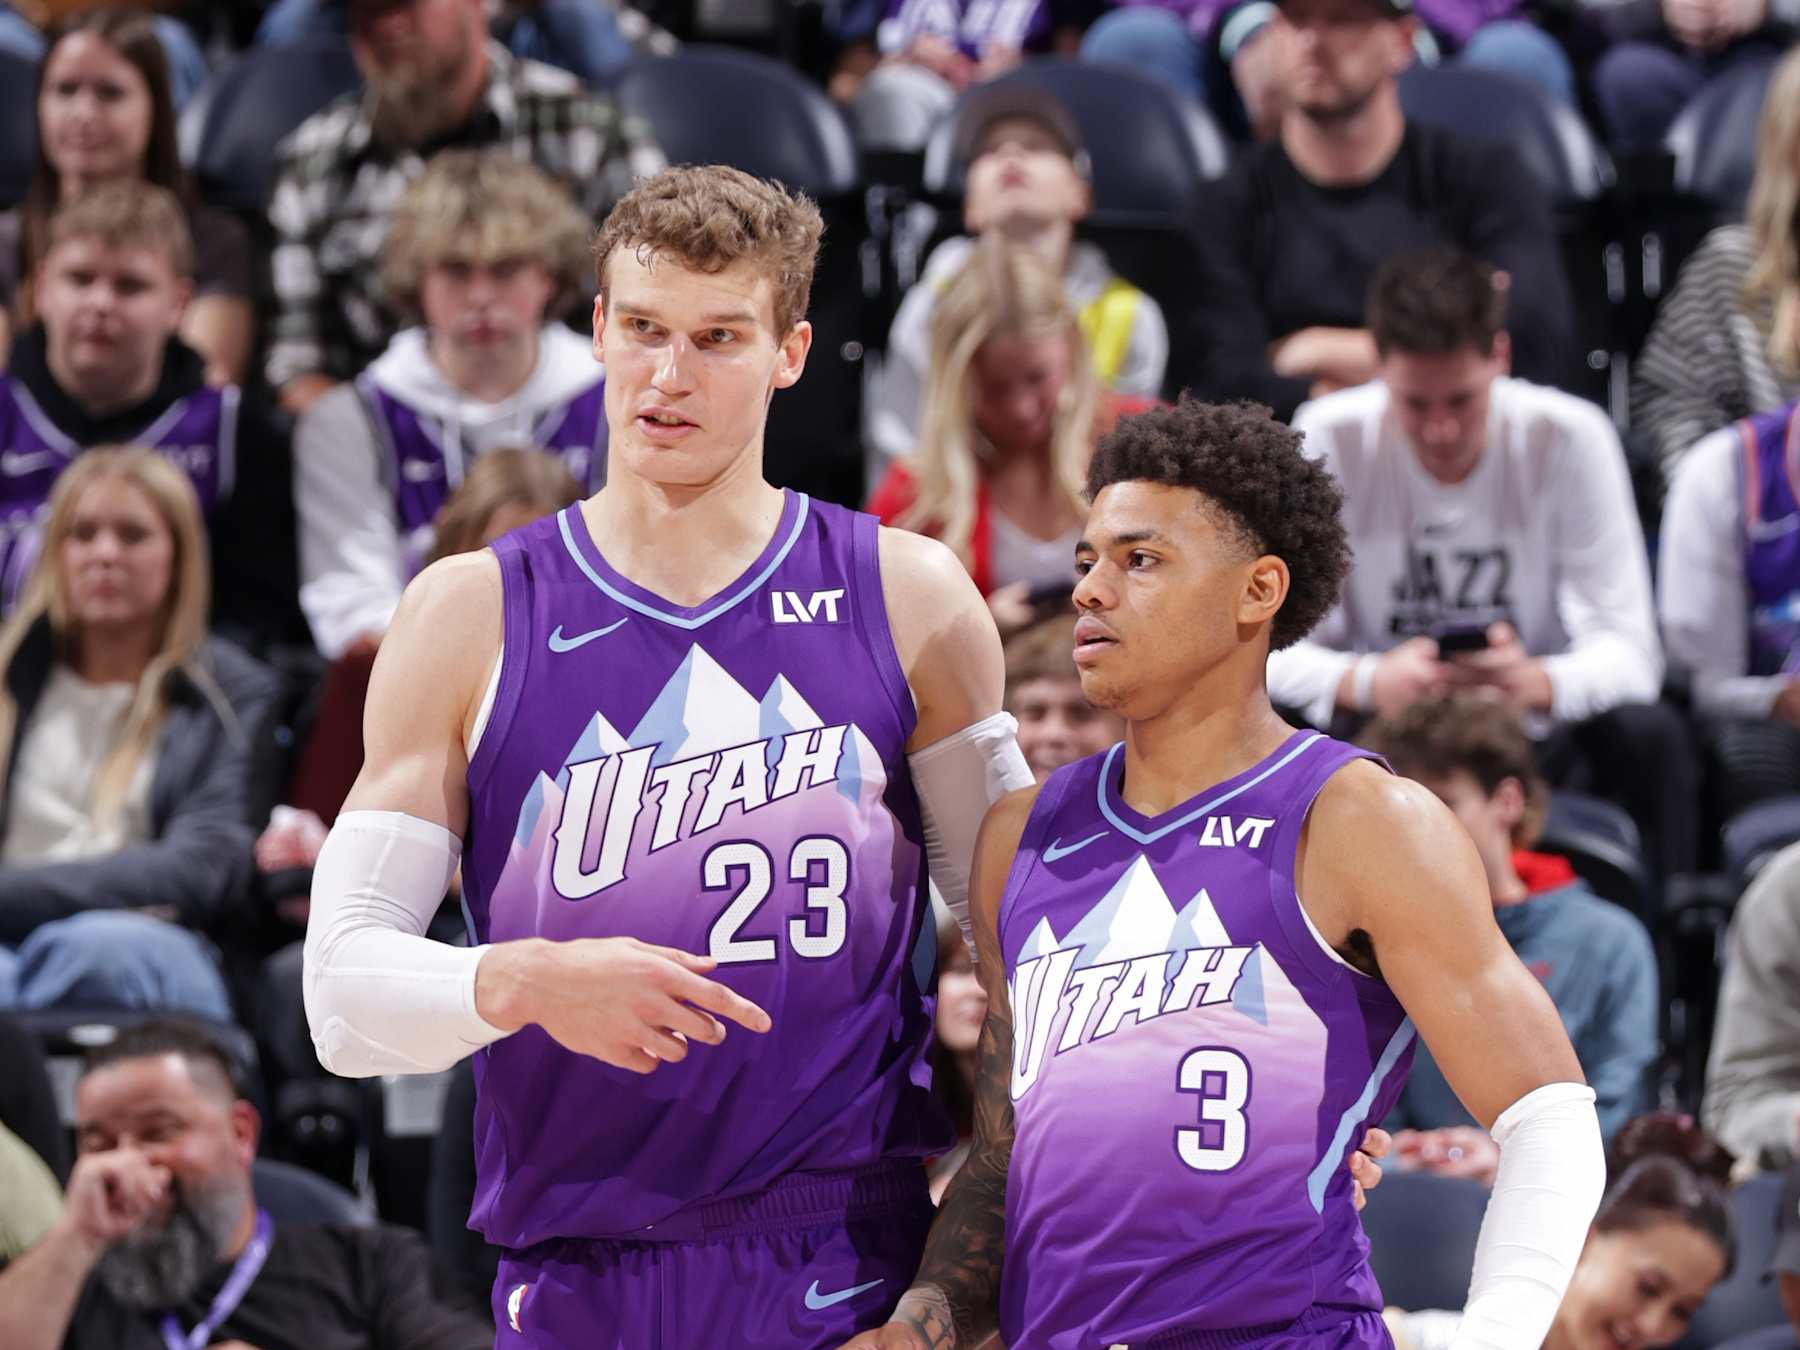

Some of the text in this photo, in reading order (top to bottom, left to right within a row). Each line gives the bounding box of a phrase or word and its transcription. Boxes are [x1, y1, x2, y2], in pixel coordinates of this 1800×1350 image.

[770, 588, 846, 623] LVT
[551, 720, 850, 901] UTAH
[1199, 815, 1276, 848] LVT
[701, 834, 852, 967] 23
[1008, 945, 1254, 1102] UTAH
[1173, 1045, 1253, 1176] 3
